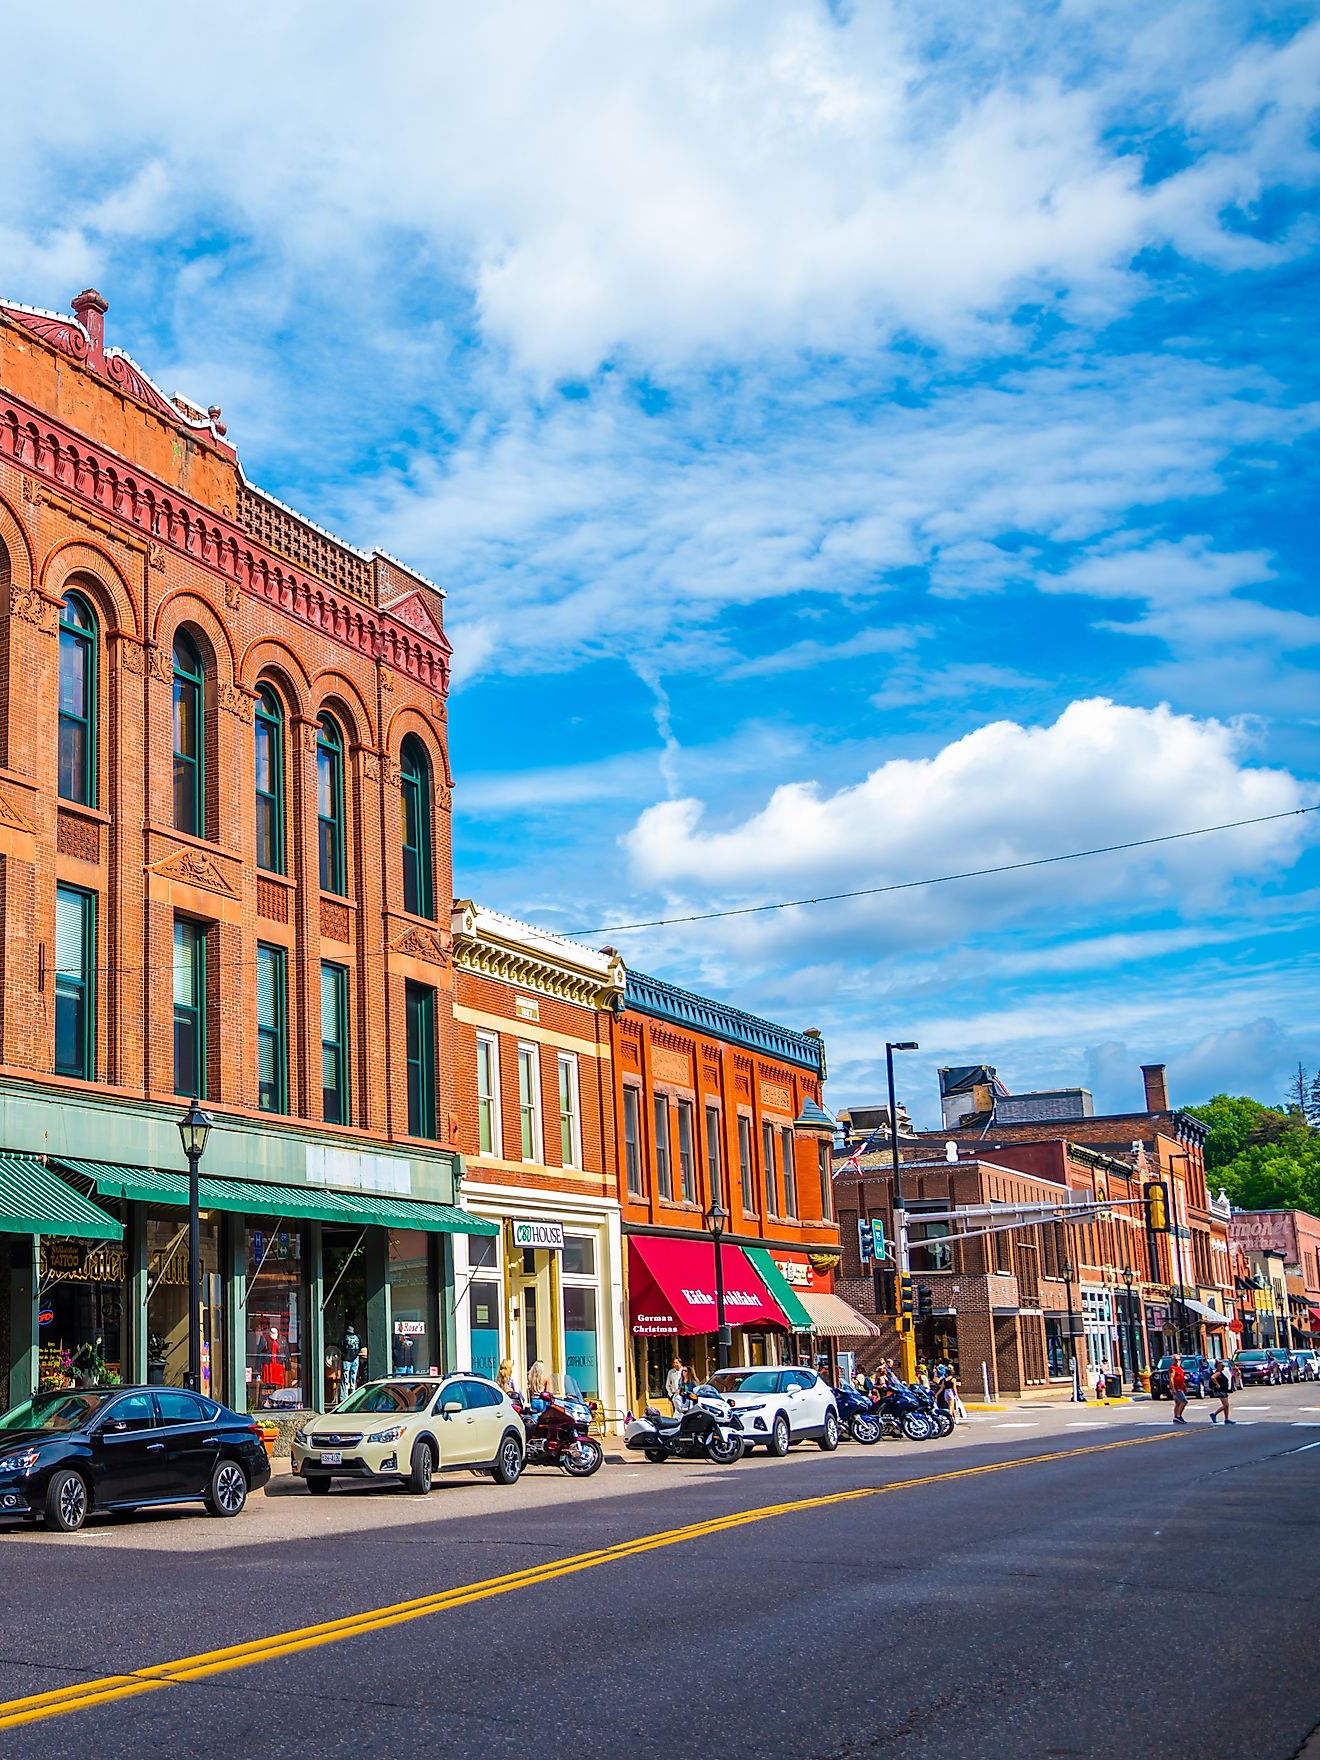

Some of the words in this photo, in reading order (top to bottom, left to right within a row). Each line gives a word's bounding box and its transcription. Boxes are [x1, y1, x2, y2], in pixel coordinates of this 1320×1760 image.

[532, 1226, 562, 1244] HOUSE
[51, 1255, 79, 1267] TATTOO
[681, 1288, 715, 1305] Käthe
[637, 1314, 673, 1323] German
[403, 1322, 423, 1332] Rose's
[632, 1325, 678, 1334] Christmas
